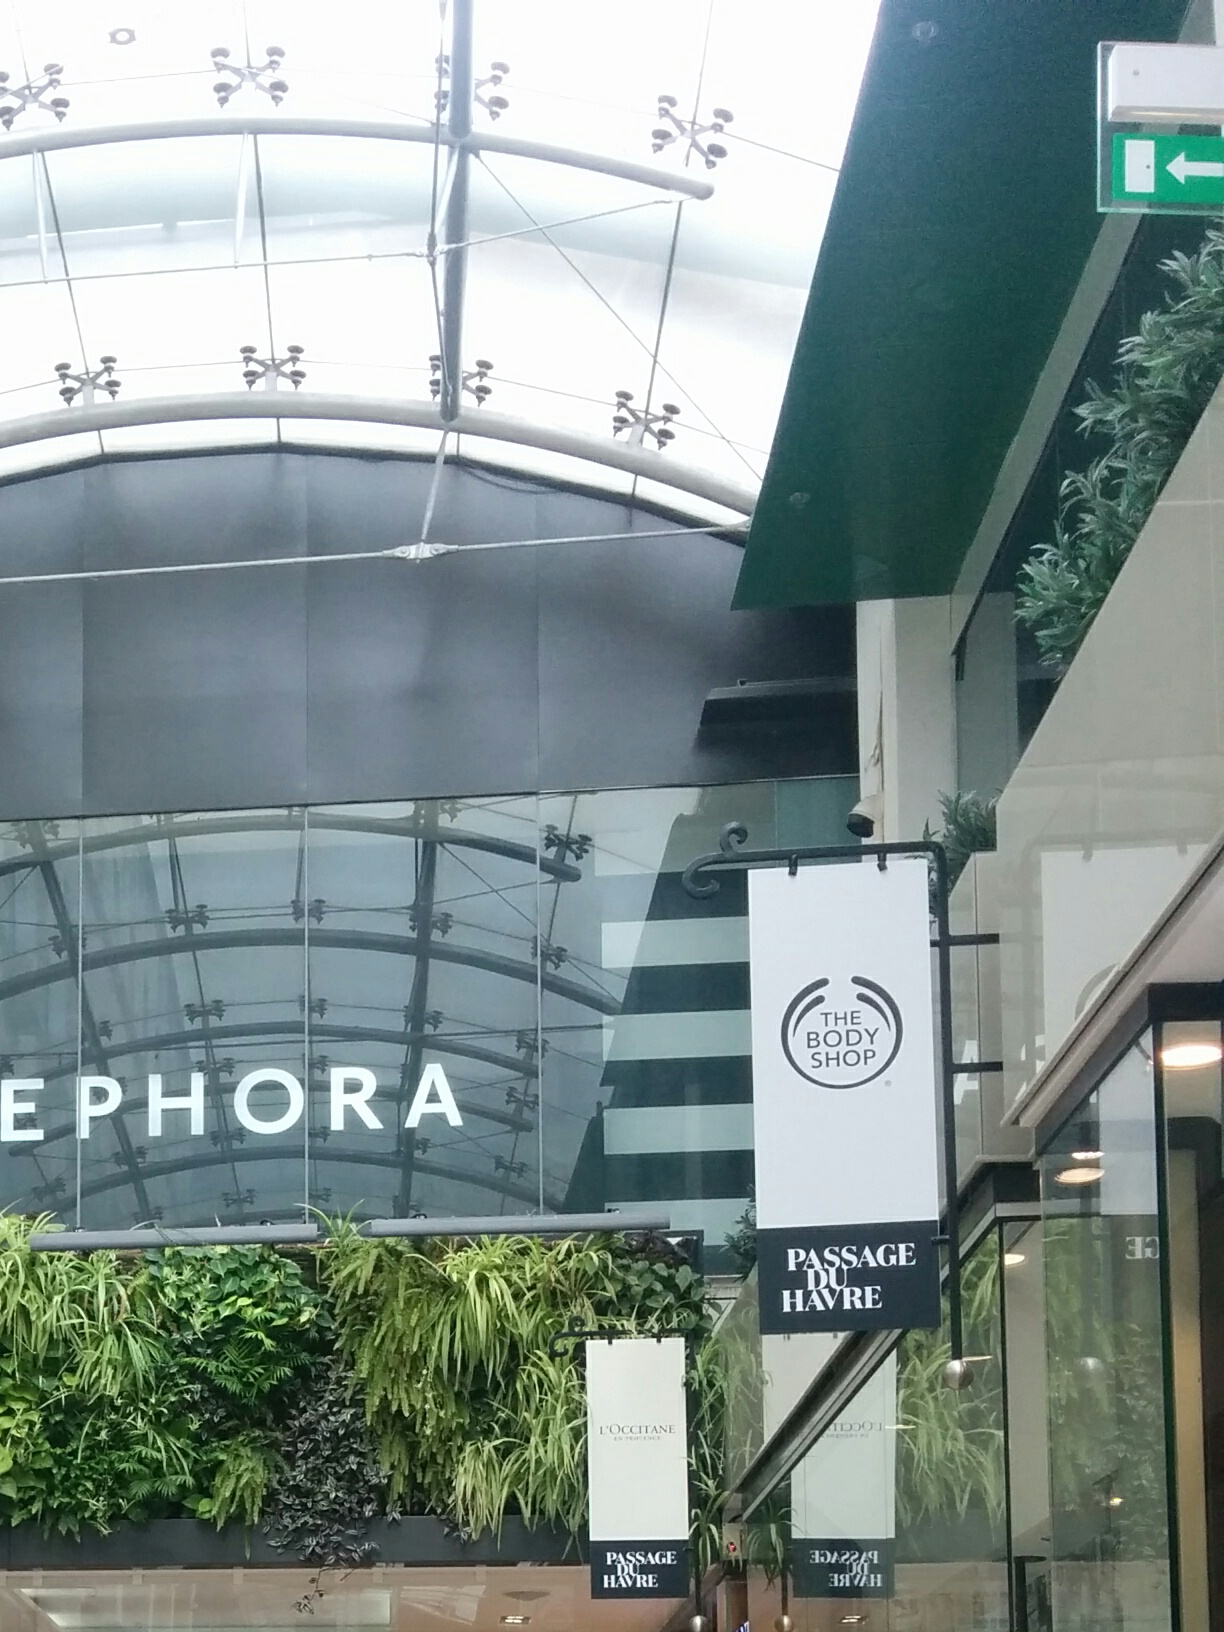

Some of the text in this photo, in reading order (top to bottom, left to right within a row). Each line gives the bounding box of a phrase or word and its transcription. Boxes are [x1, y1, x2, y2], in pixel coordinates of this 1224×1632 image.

[820, 1010, 862, 1027] THE
[806, 1027, 880, 1050] BODY
[810, 1049, 877, 1069] SHOP
[786, 1243, 917, 1272] PASSAGE
[806, 1267, 849, 1291] DU
[781, 1285, 883, 1314] HAVRE
[606, 1551, 677, 1566] PASSAGE
[617, 1564, 641, 1577] DU
[603, 1574, 658, 1589] HAVRE
